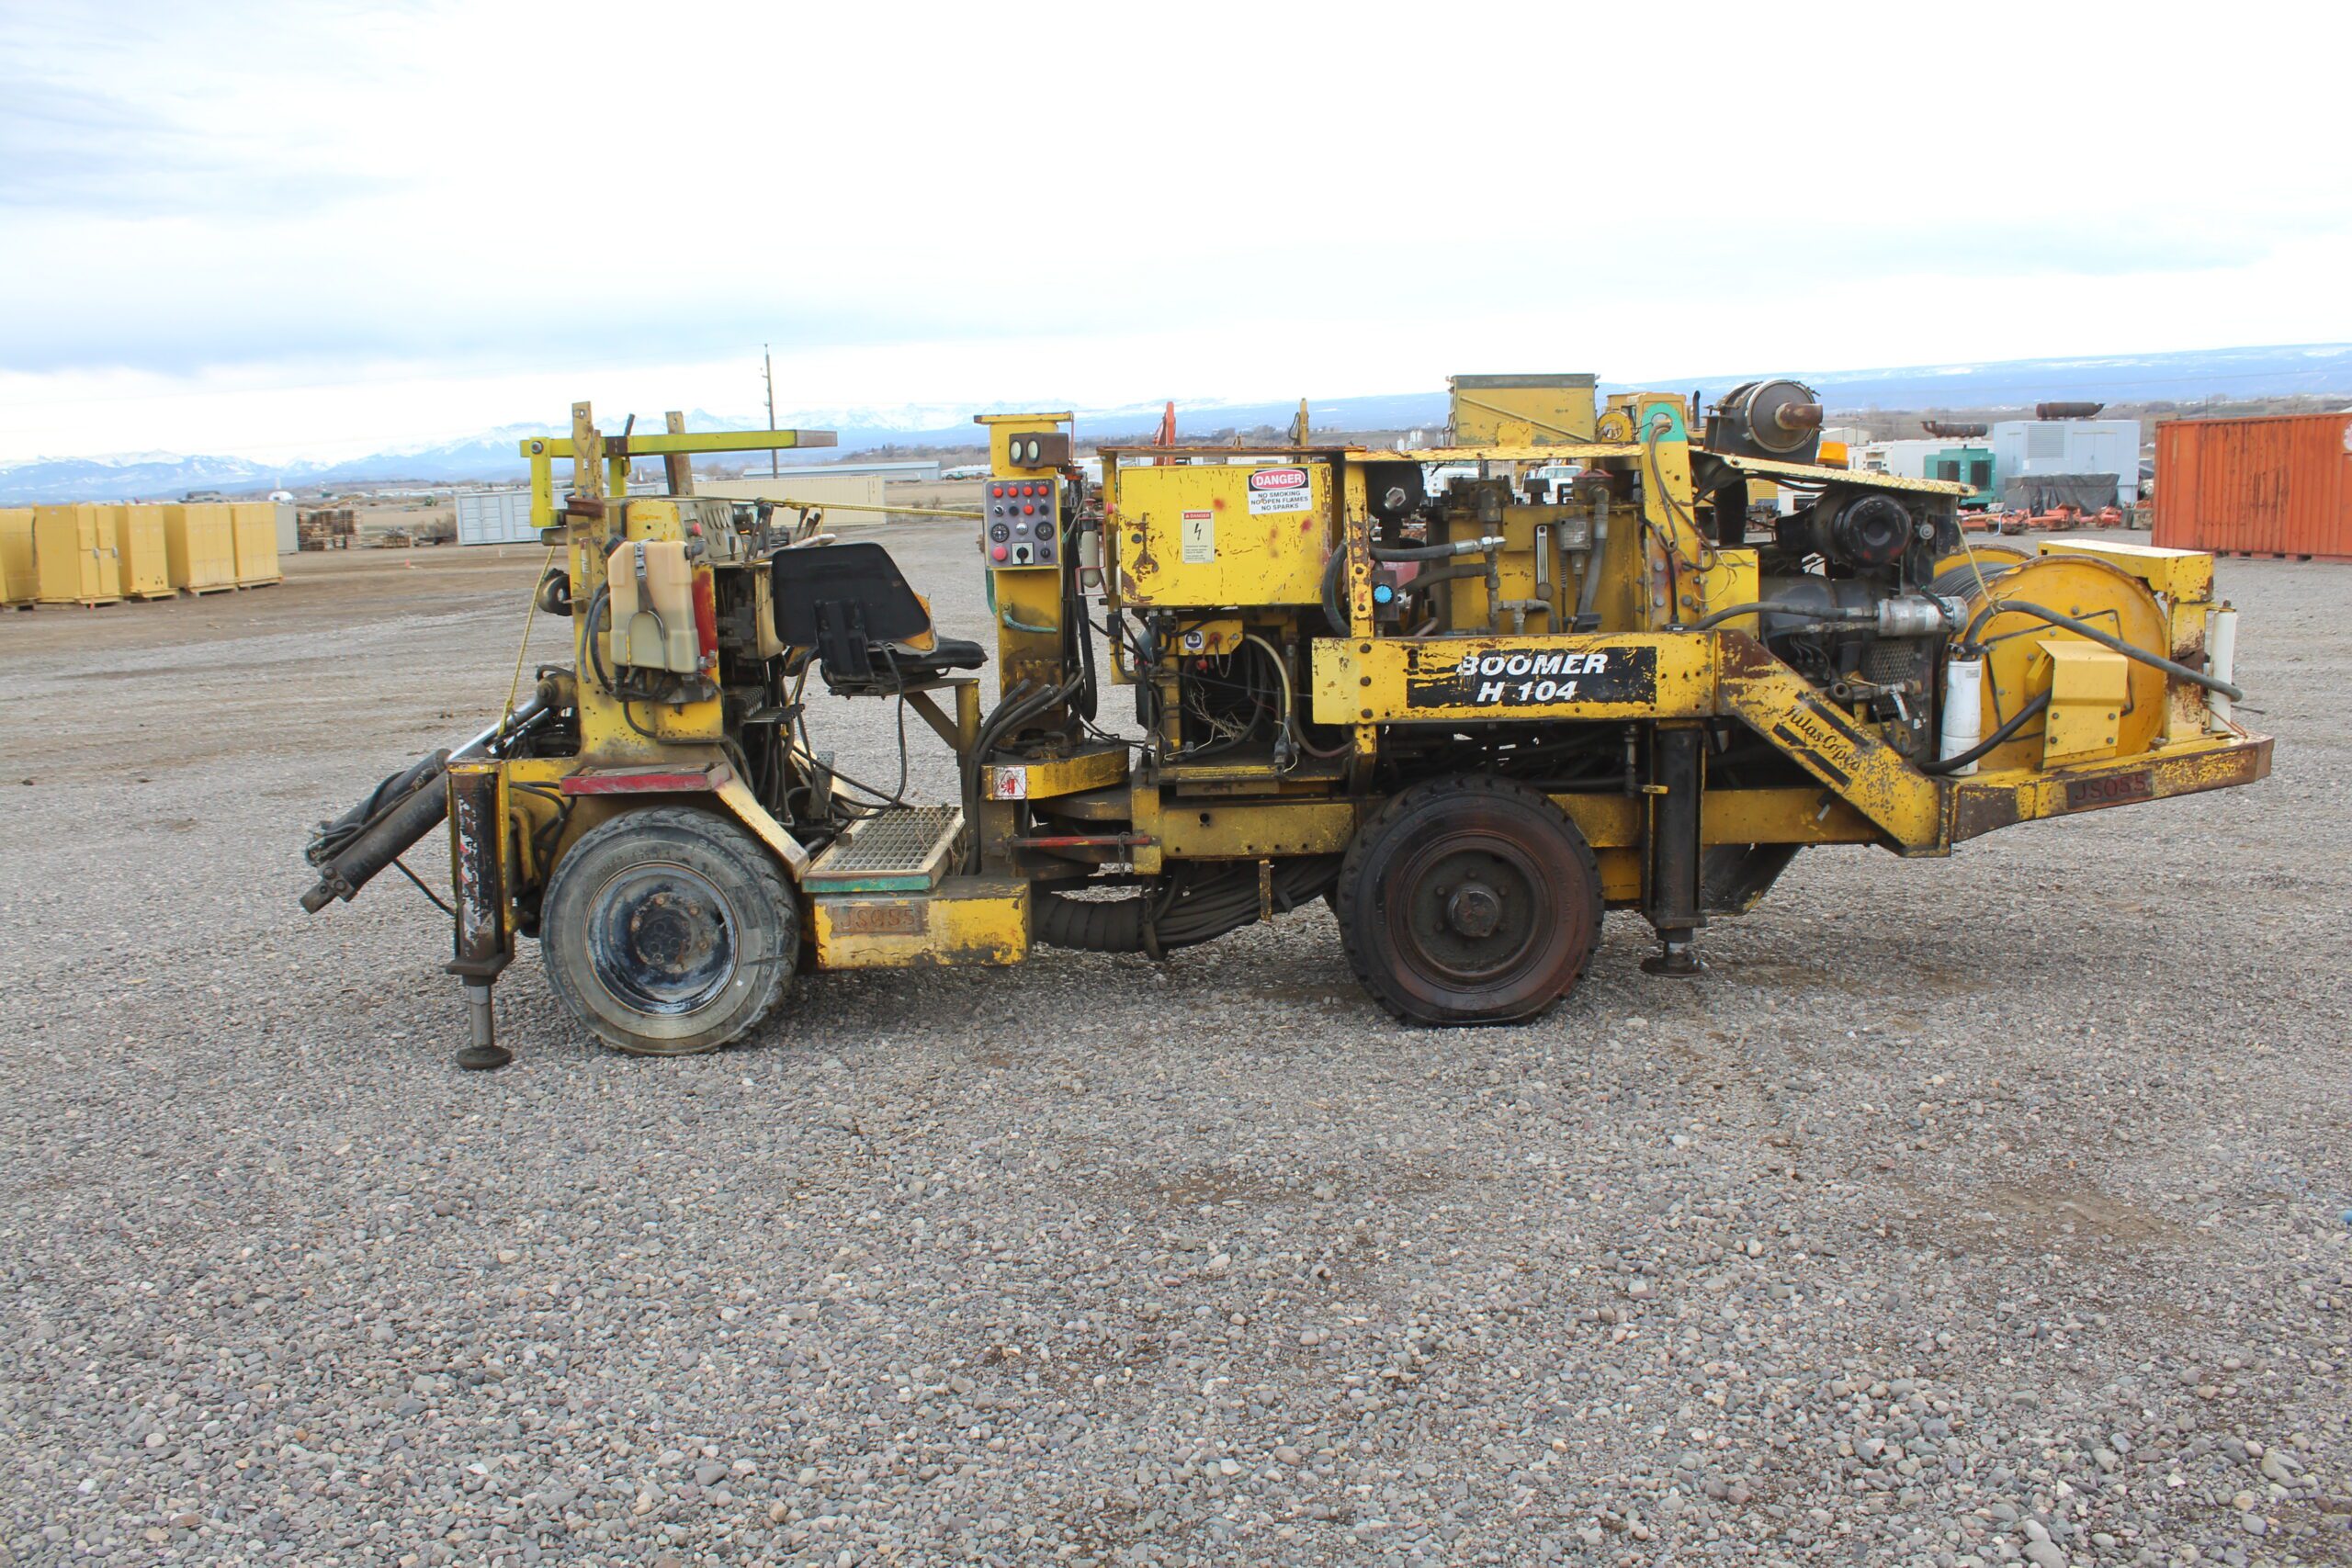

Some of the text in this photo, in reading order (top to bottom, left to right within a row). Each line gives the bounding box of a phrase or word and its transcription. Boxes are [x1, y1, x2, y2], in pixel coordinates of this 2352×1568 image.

[1255, 473, 1303, 486] DANGER
[1269, 490, 1301, 498] SMOKING
[1272, 502, 1299, 511] SPARKS
[1455, 653, 1608, 677] BOOMER
[1476, 680, 1578, 703] H 104
